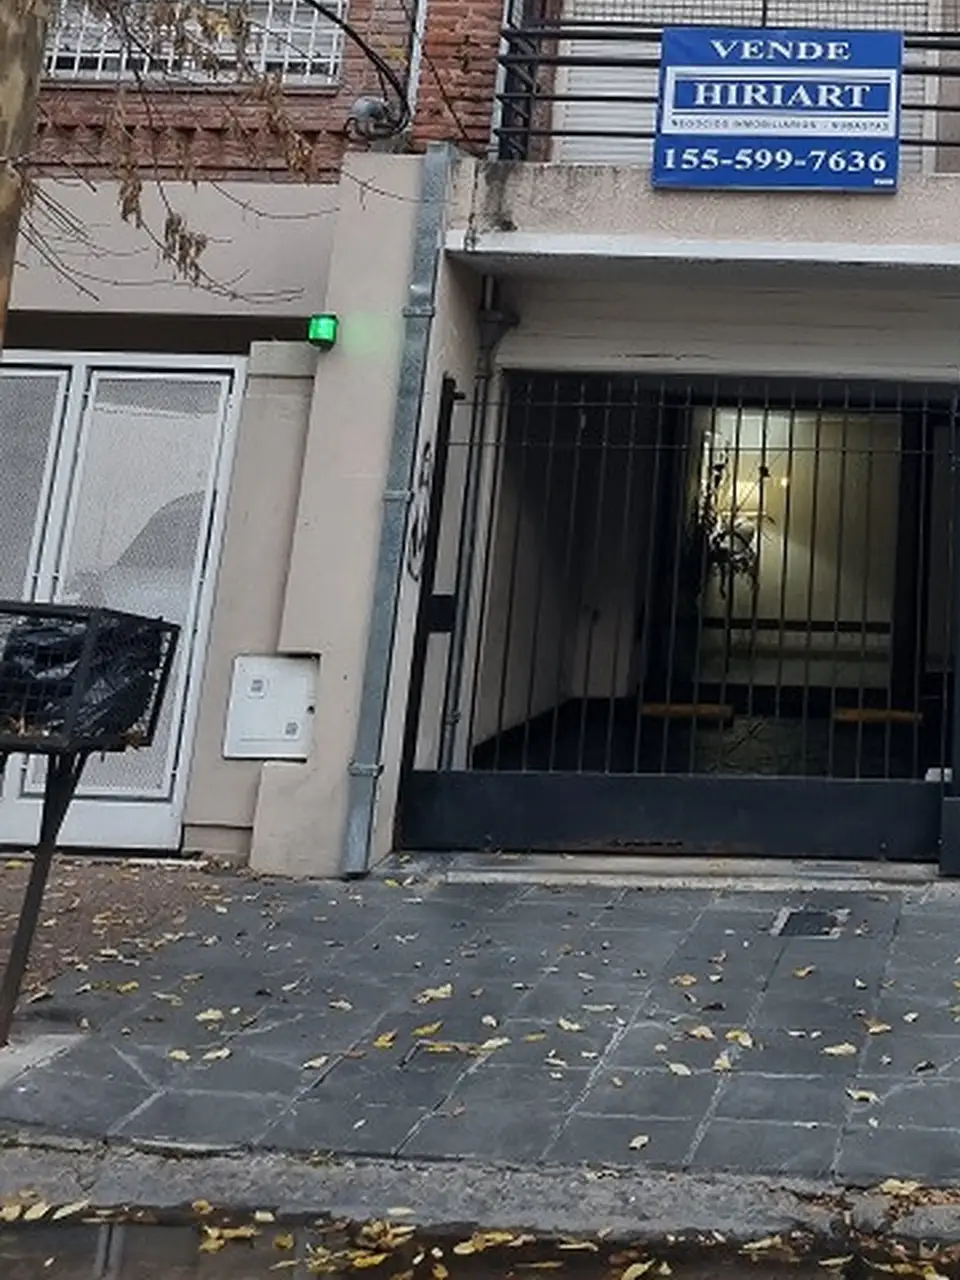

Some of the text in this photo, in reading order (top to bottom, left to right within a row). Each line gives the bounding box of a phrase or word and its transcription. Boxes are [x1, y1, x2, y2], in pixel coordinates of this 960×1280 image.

[710, 39, 852, 60] VENDE
[694, 82, 871, 108] HIRIART
[663, 147, 887, 172] 155-599-7636
